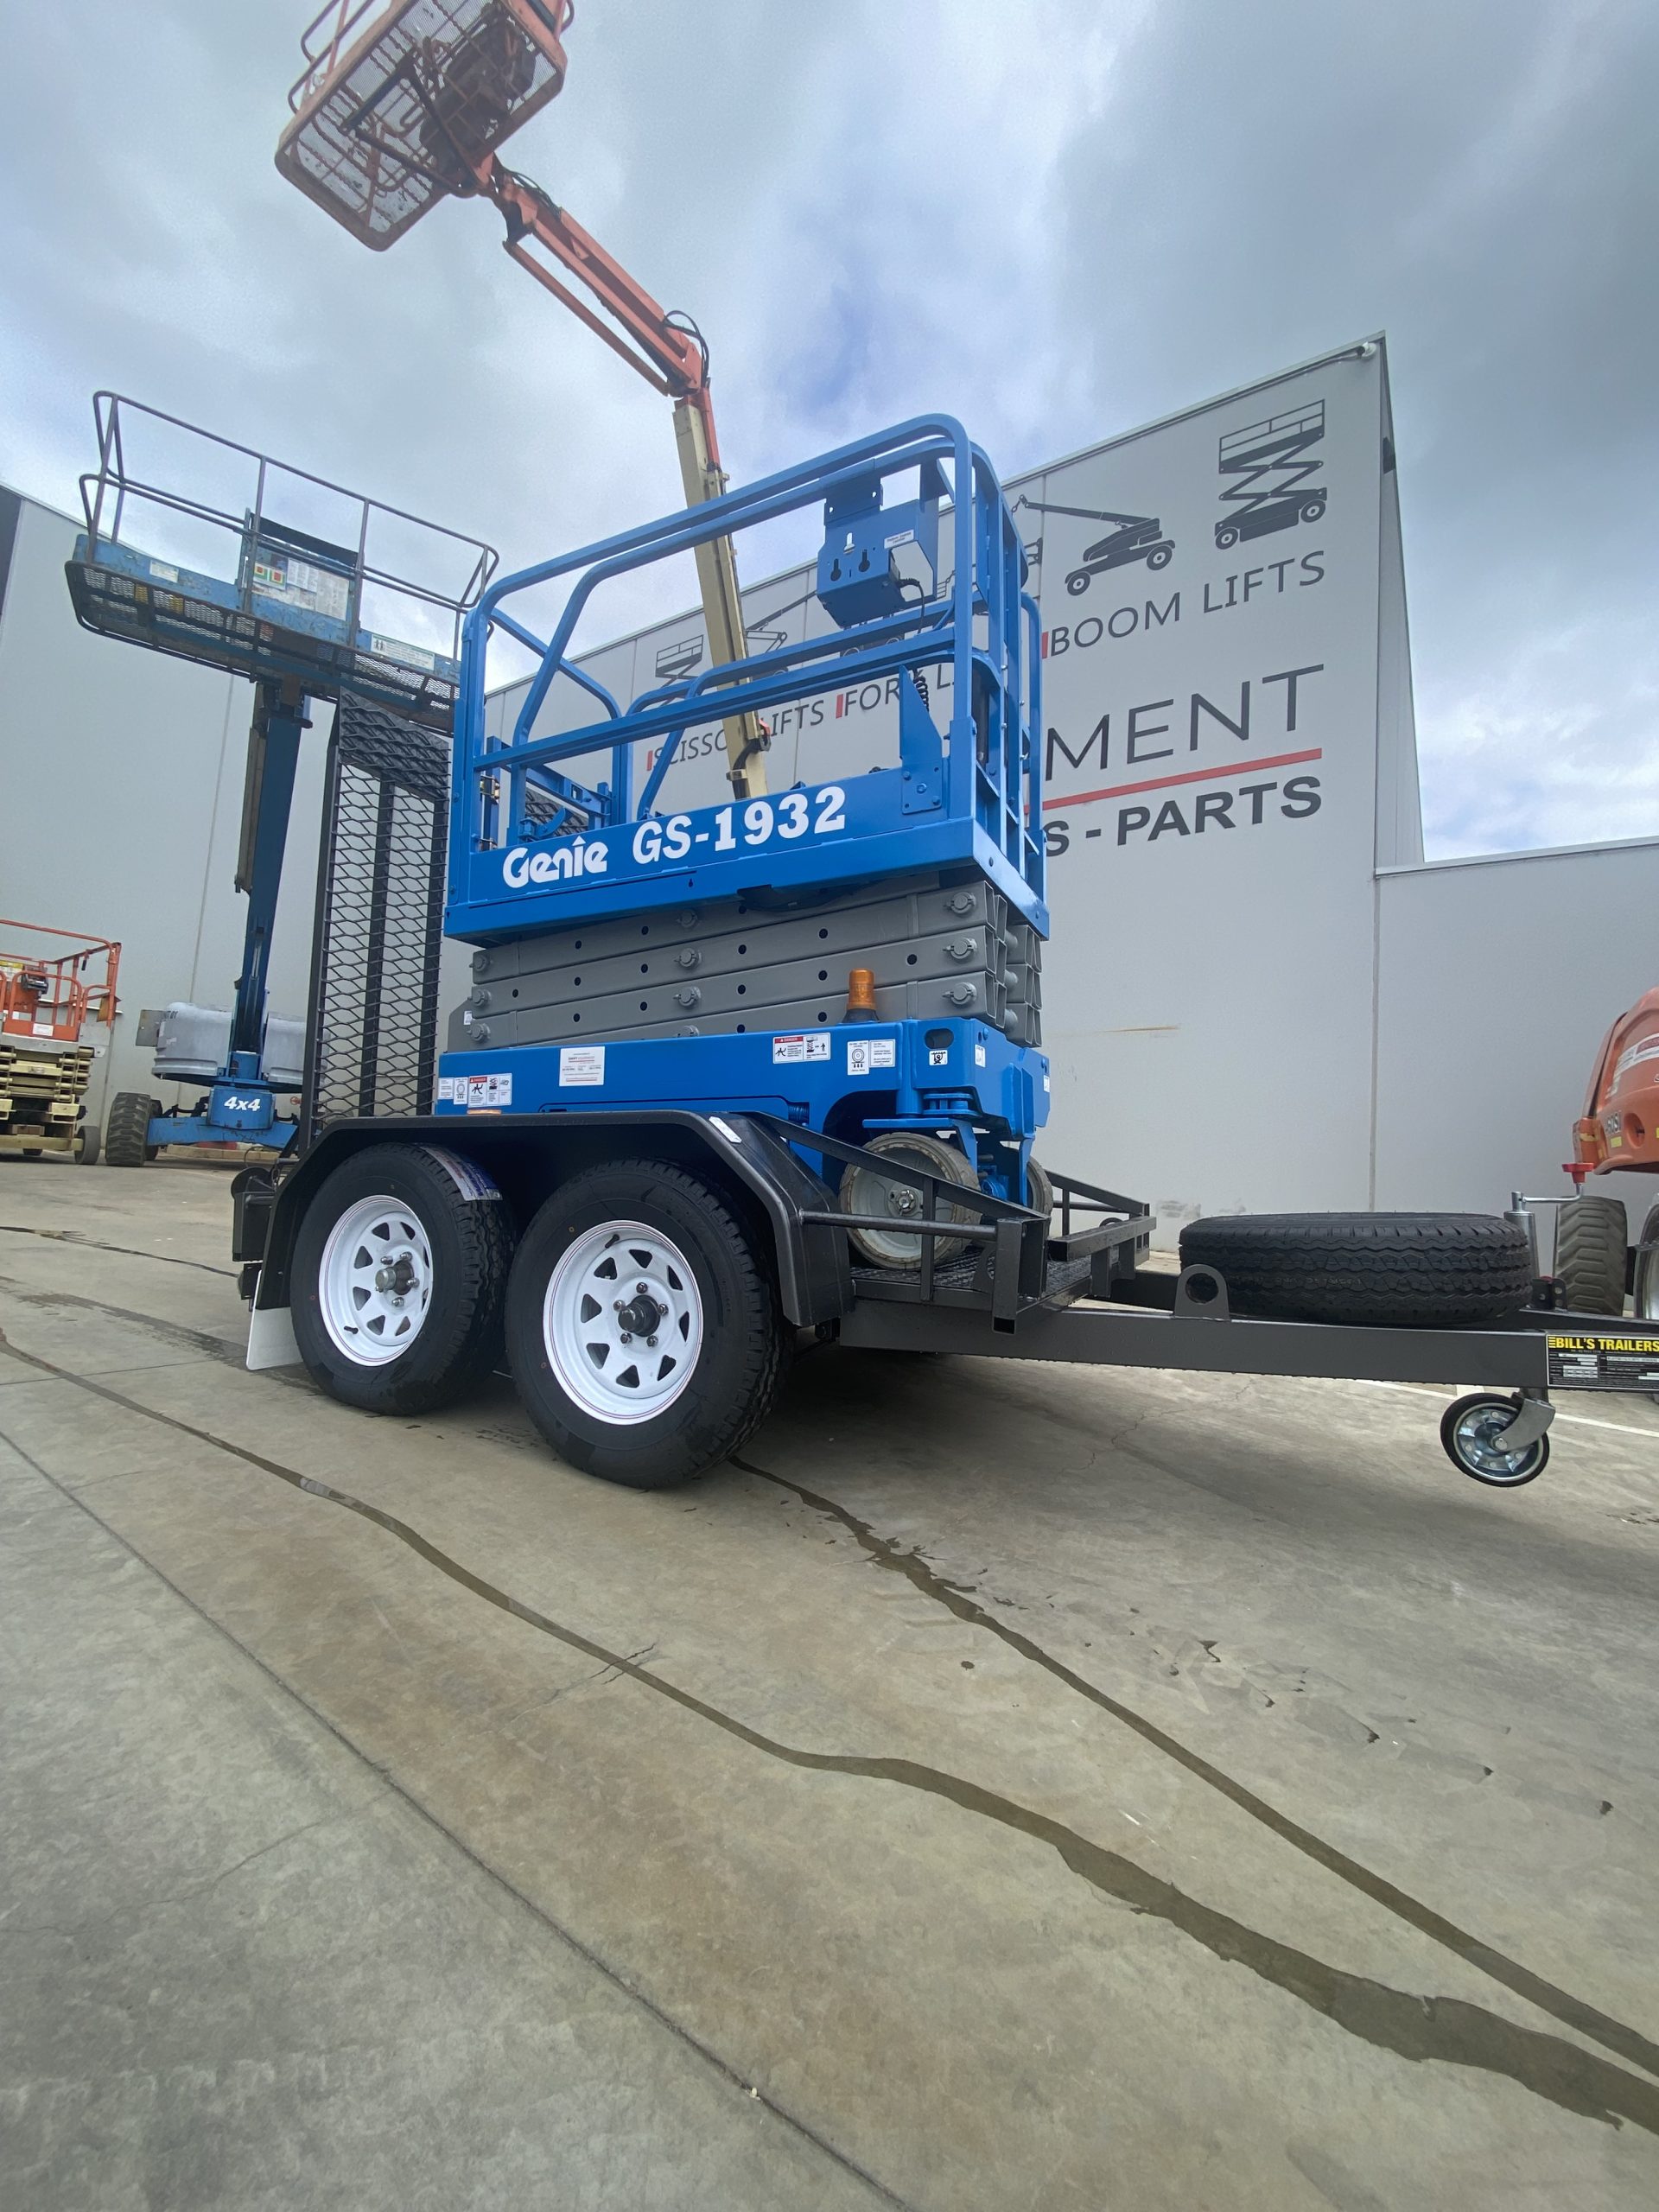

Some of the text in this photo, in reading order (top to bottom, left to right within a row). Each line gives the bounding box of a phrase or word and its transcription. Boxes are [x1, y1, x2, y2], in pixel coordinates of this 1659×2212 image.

[1051, 550, 1325, 657] BOOM LIFTS
[844, 670, 922, 716] FOR
[760, 700, 824, 737] IFTS
[1117, 776, 1322, 846] PARTS
[503, 785, 846, 888] Genie GS-1932
[224, 1096, 261, 1111] 4x4
[1556, 1337, 1659, 1351] BILL'S TRAILERS
